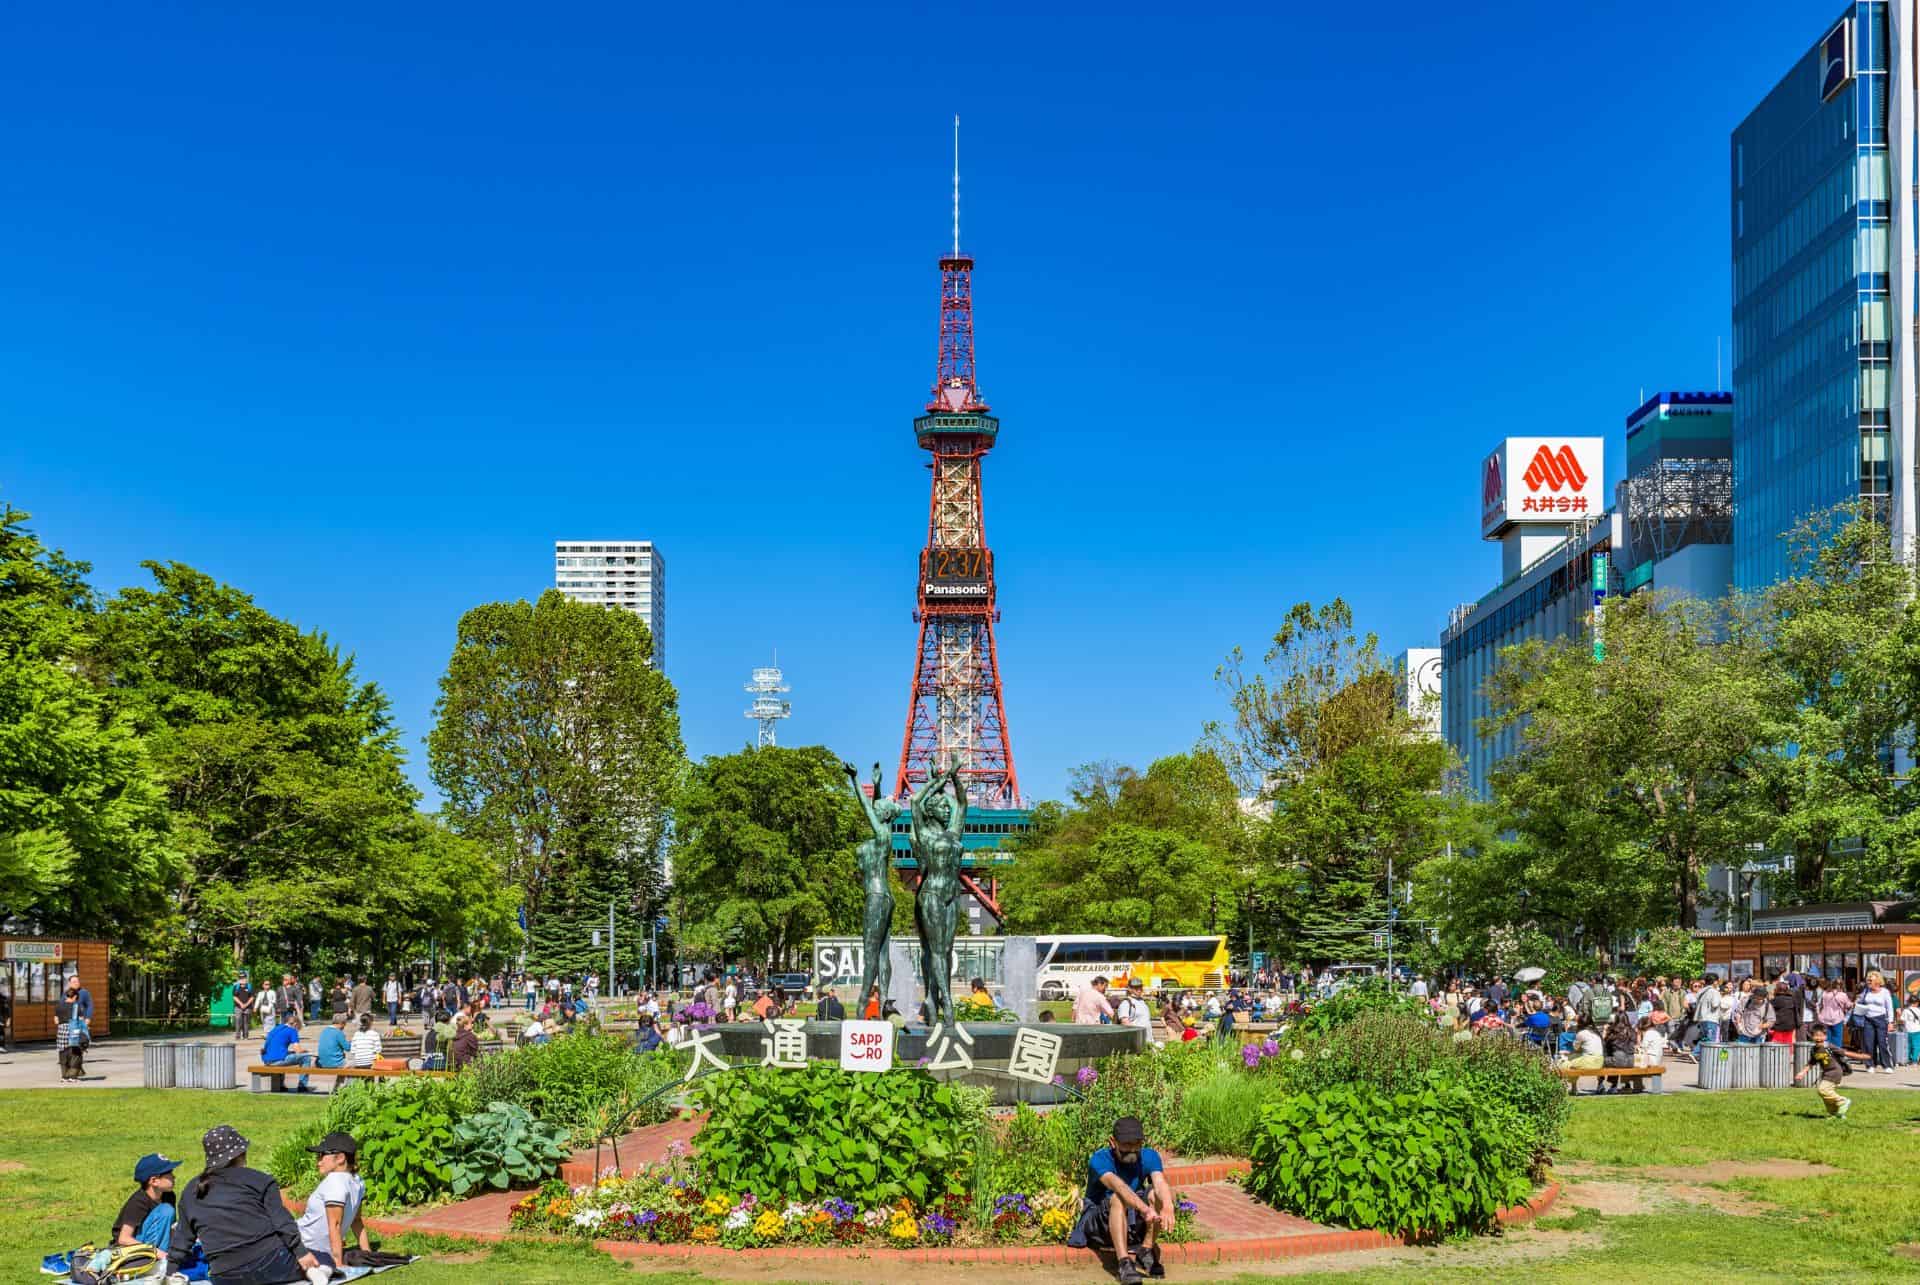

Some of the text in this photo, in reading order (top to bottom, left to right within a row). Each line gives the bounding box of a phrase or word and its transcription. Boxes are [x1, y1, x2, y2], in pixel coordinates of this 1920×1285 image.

[1522, 496, 1588, 512] 丸井今井
[925, 583, 988, 594] Panasonic
[1113, 964, 1130, 972] BUS
[850, 1032, 883, 1045] SAPP
[866, 1047, 883, 1060] RO
